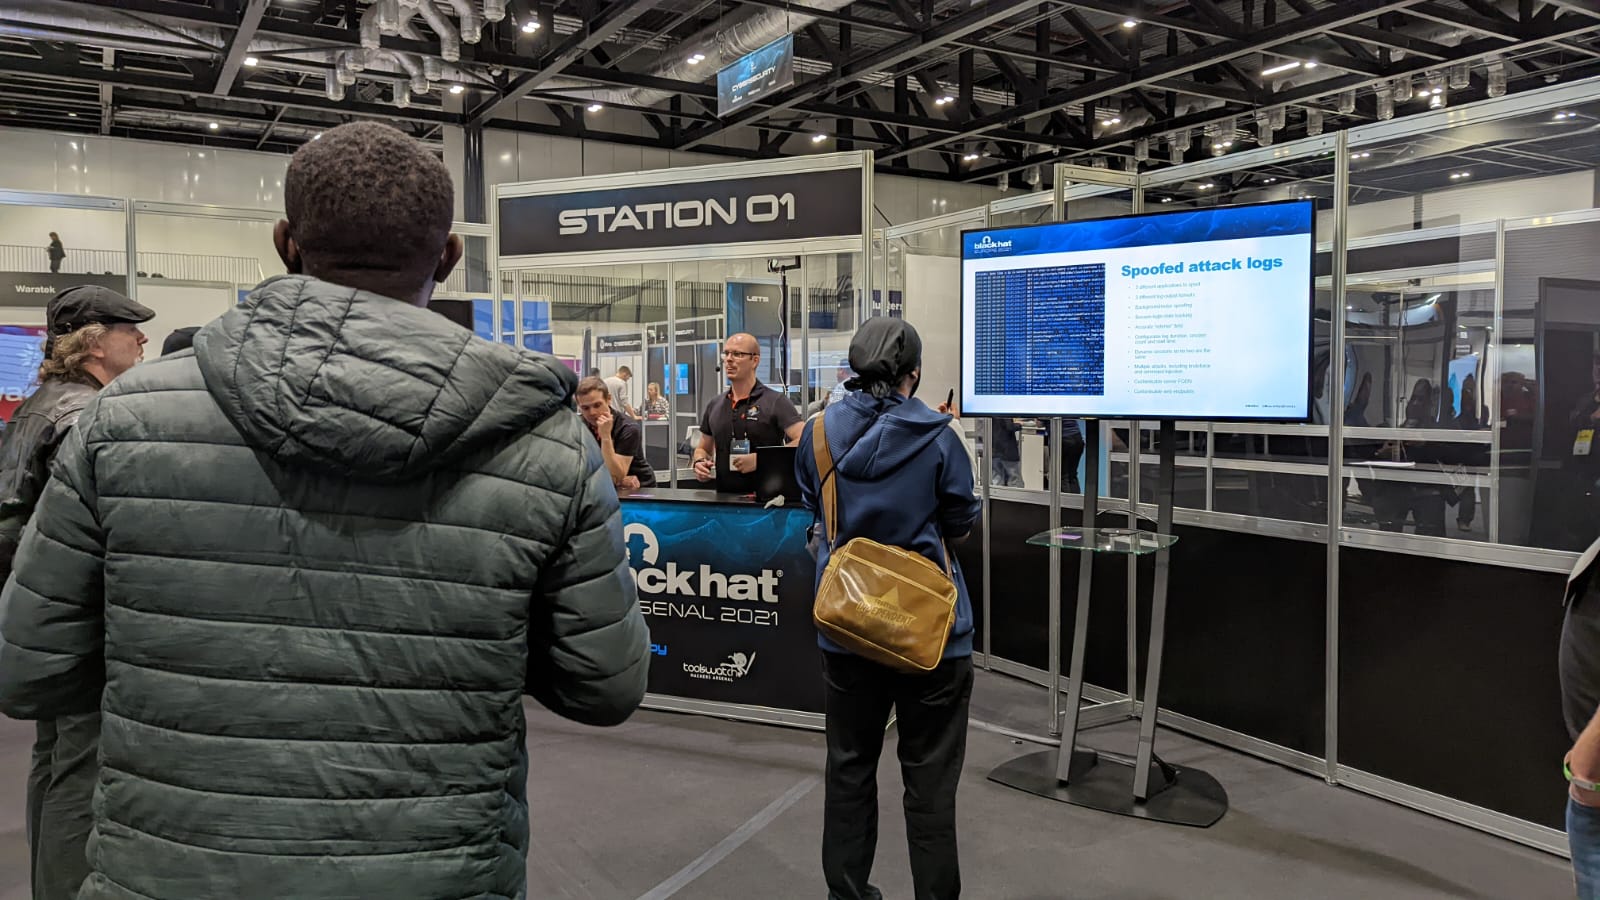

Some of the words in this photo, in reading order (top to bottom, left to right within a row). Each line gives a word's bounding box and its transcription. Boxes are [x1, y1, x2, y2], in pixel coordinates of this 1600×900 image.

[558, 197, 737, 235] STATION
[746, 192, 795, 223] 01
[974, 241, 997, 249] black
[997, 240, 1012, 248] hat
[1121, 262, 1184, 279] Spoofed
[1188, 258, 1242, 273] attack
[1247, 256, 1283, 271] logs
[15, 285, 56, 293] Waratek
[640, 600, 714, 620] SENAL
[721, 606, 778, 626] 2021
[683, 662, 738, 677] toolswatch
